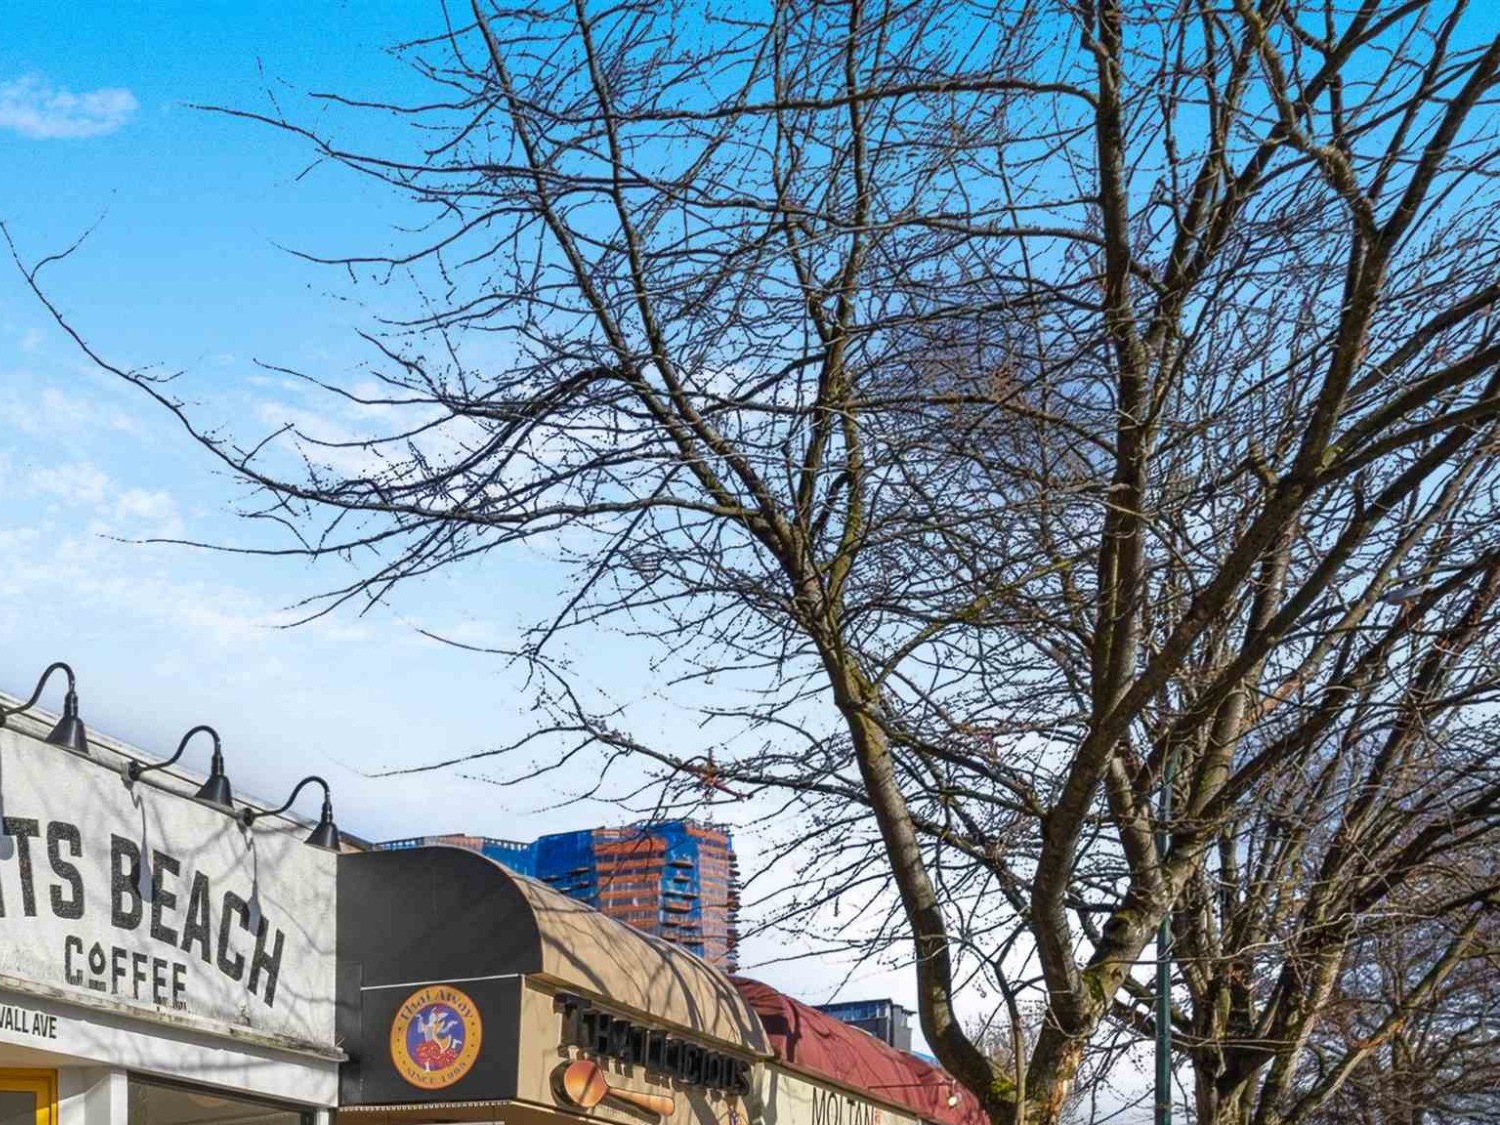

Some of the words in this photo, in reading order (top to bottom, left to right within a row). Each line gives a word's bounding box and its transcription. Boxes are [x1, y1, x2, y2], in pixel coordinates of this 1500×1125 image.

[111, 832, 286, 1008] BEACH
[63, 934, 187, 1004] COFFEE
[31, 1012, 58, 1040] AVE
